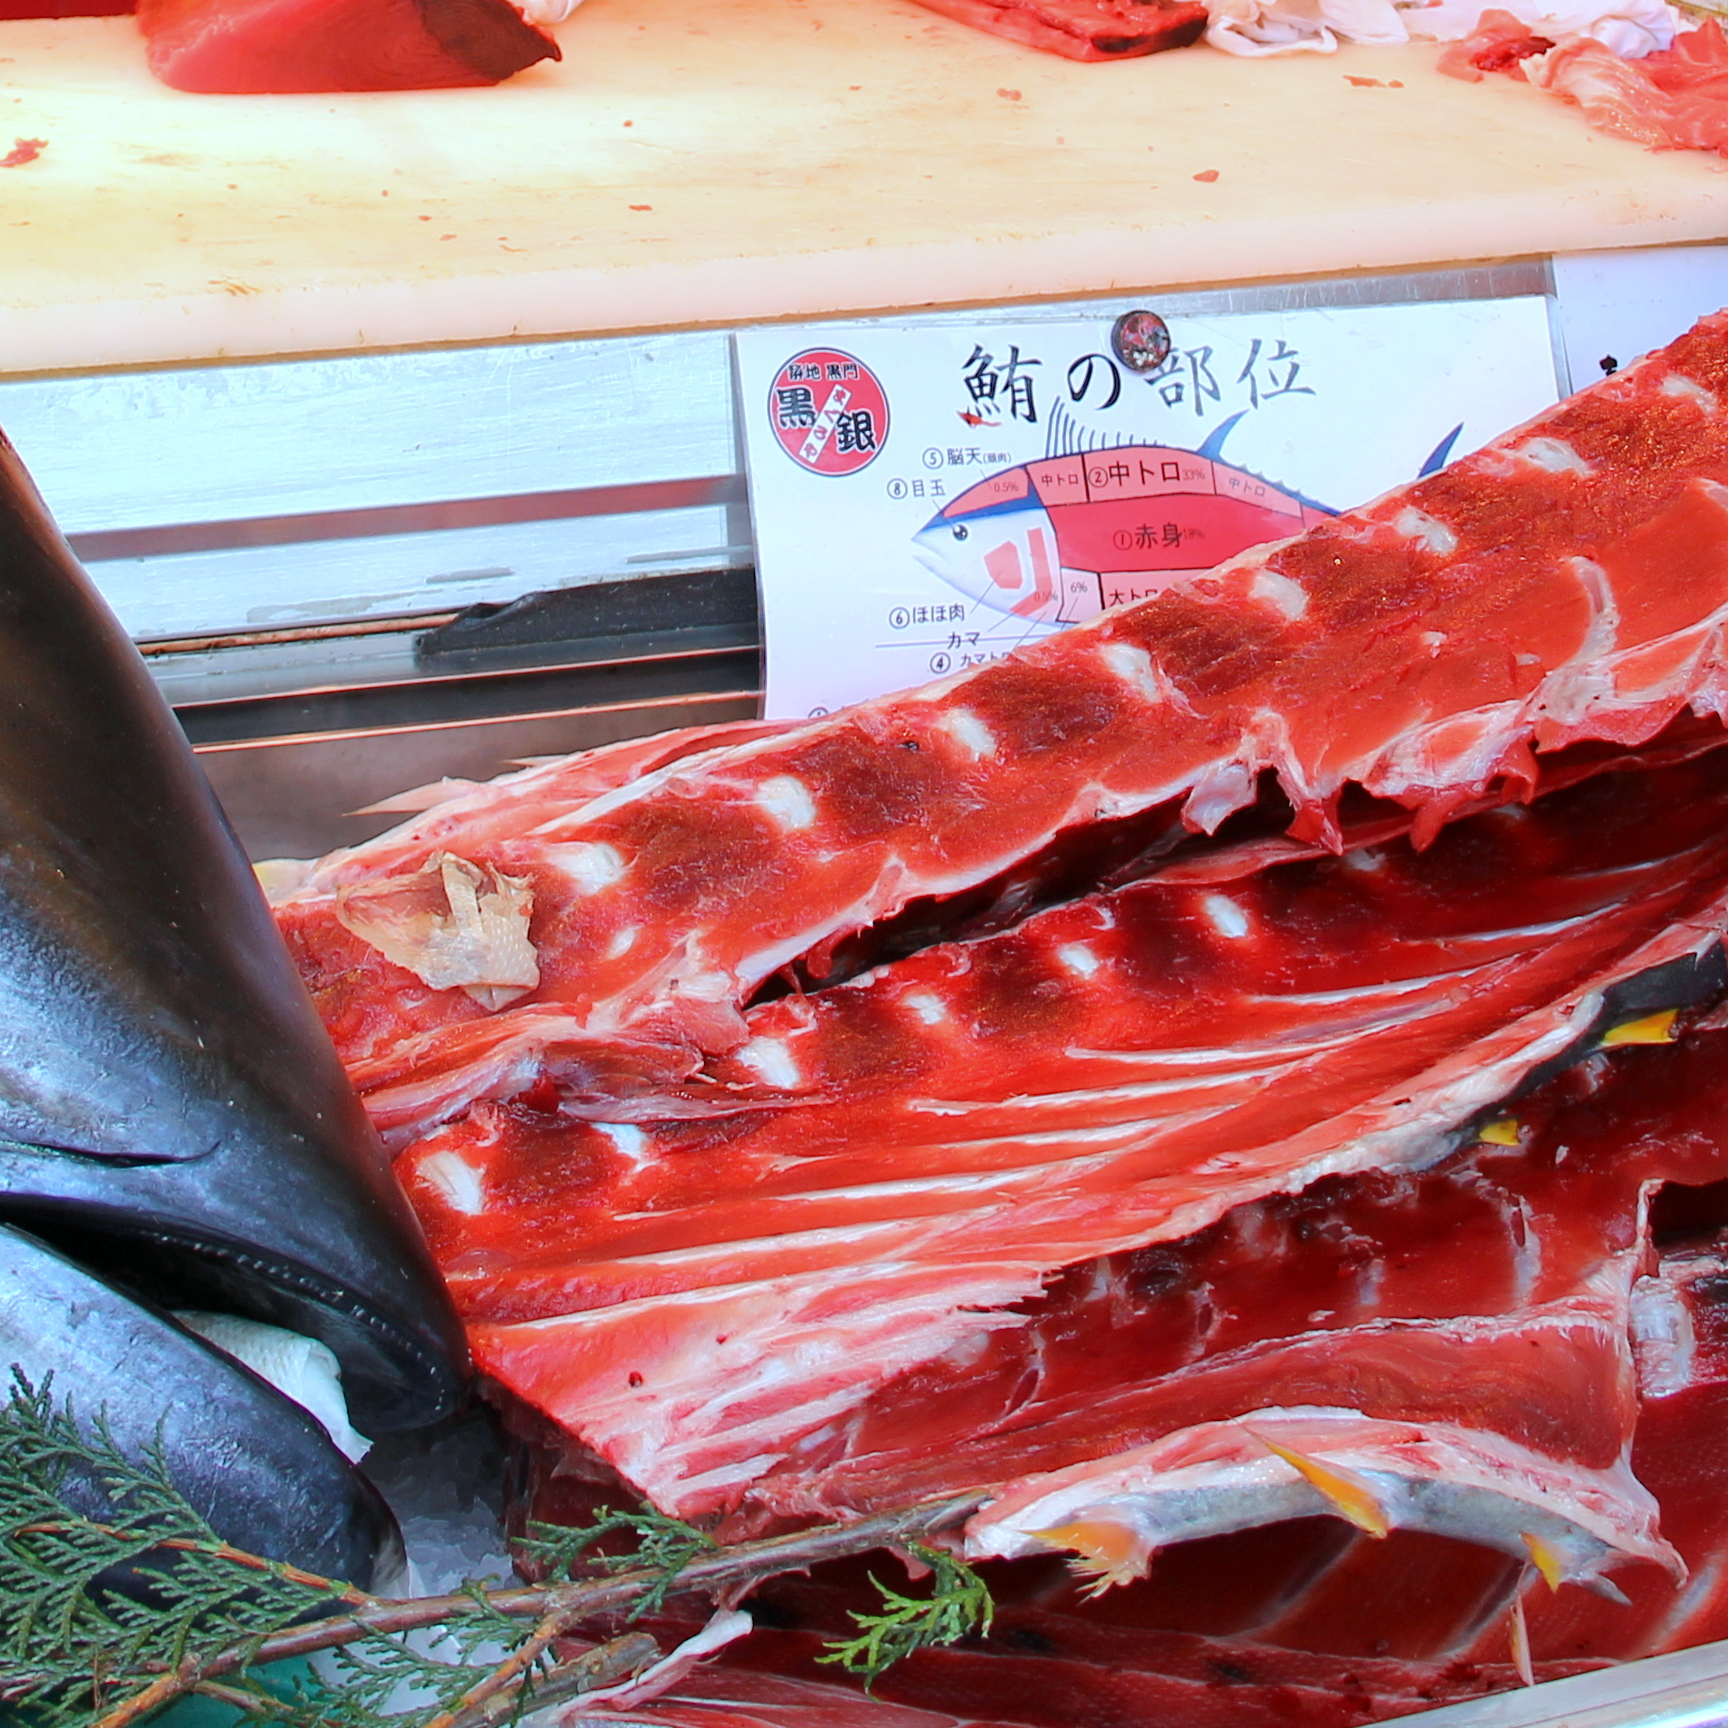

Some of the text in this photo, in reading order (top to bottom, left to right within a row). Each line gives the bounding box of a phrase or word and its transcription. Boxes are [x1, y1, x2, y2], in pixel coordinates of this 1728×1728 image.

[960, 338, 1316, 424] 鮪の部位
[1040, 473, 1080, 488] 中トロ
[1227, 476, 1266, 498] 中トロ
[1070, 581, 1089, 595] 6%
[946, 630, 981, 650] カマ
